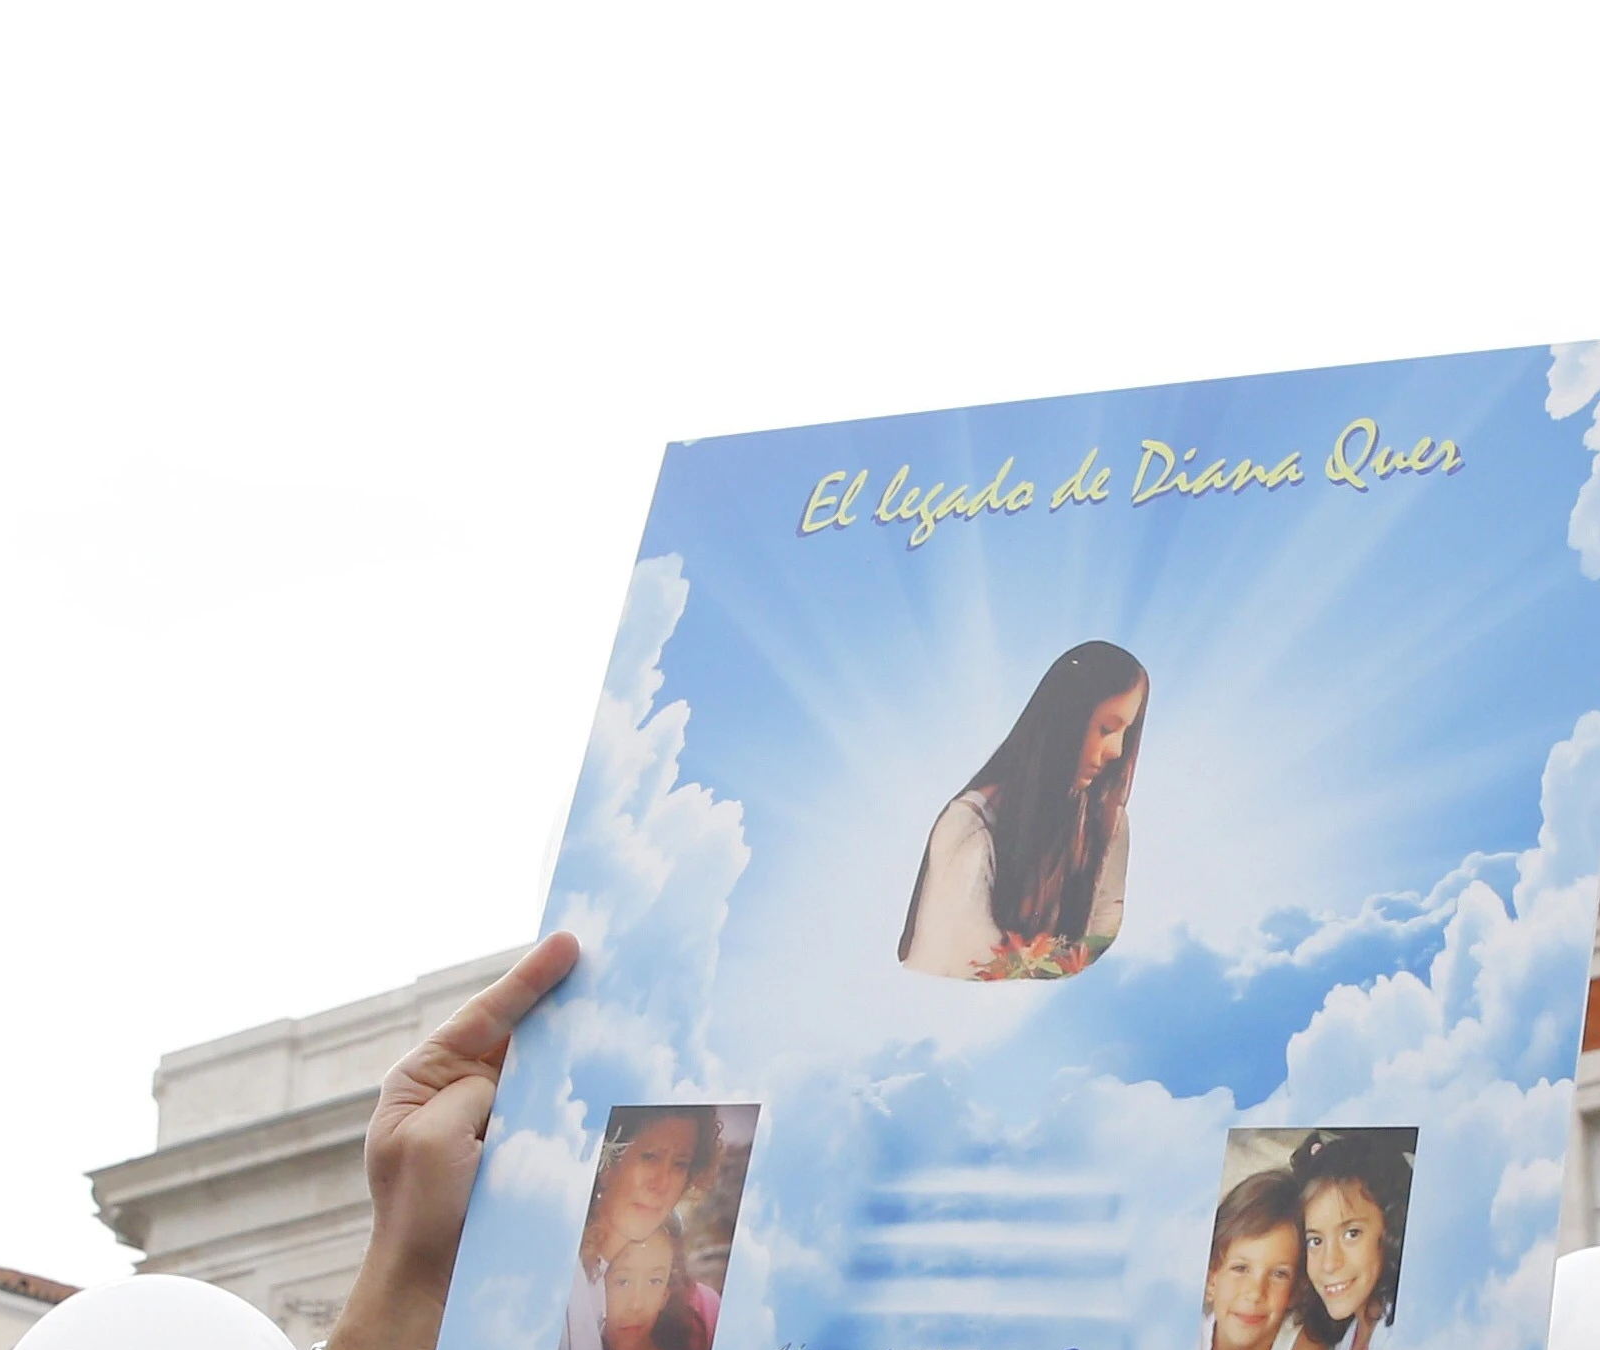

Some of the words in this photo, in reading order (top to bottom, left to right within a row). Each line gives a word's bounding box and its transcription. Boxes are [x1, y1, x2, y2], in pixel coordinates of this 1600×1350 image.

[796, 469, 869, 537] El
[874, 456, 1037, 550] legado
[1051, 447, 1111, 512] de
[1131, 439, 1305, 506] Diana
[1324, 417, 1466, 491] Quer
